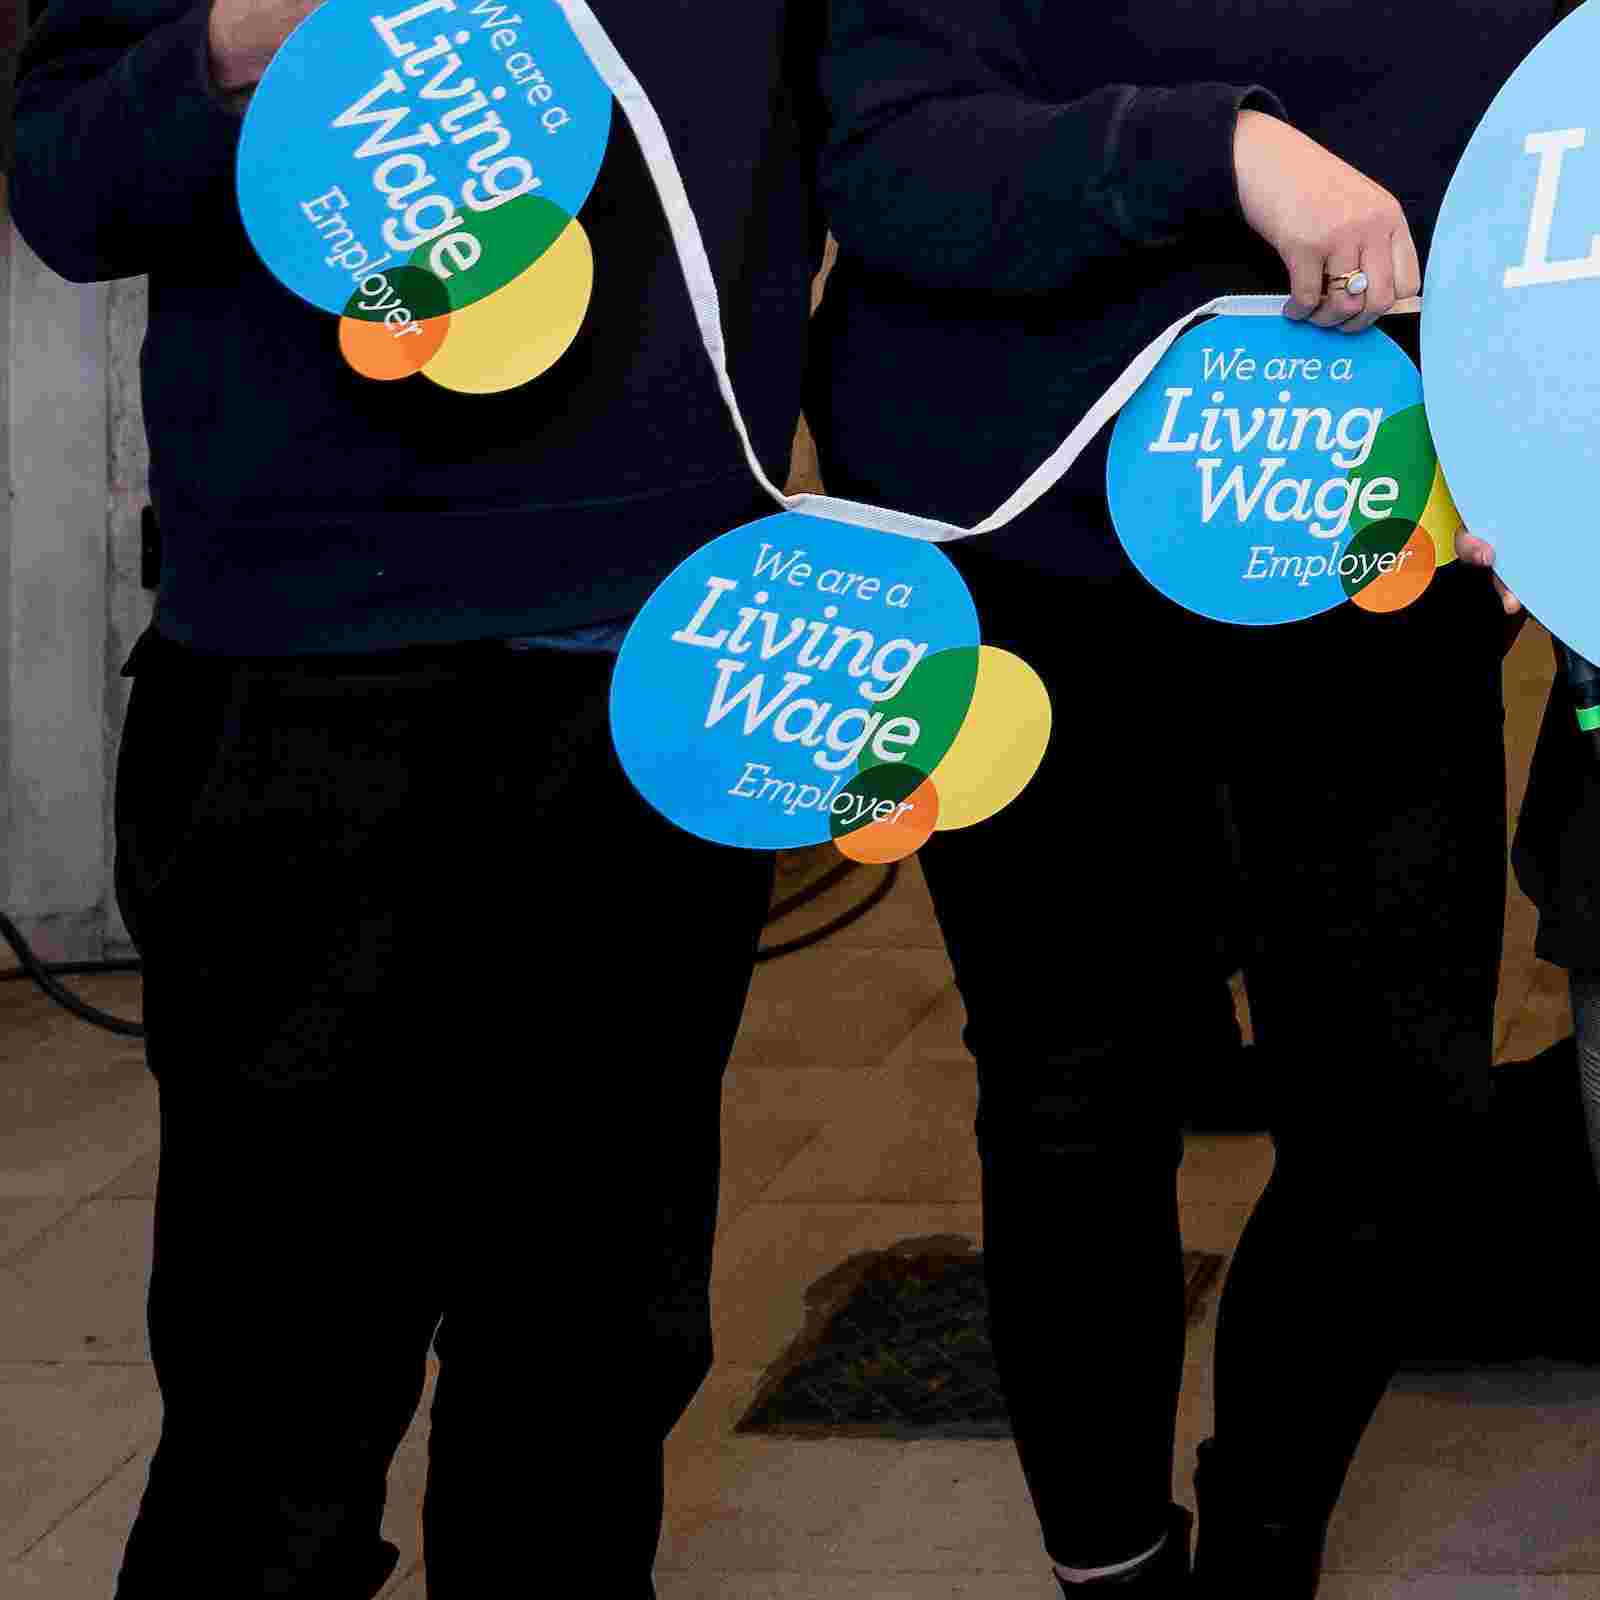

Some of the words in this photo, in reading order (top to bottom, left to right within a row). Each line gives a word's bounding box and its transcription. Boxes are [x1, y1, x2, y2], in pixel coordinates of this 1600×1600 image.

[506, 47, 552, 104] are
[542, 105, 570, 134] a
[331, 69, 481, 279] Wage
[301, 184, 423, 339] Employer
[1201, 348, 1256, 382] We
[1264, 357, 1322, 381] are
[1329, 358, 1353, 381] a
[1148, 387, 1383, 469] Living
[1196, 458, 1399, 538] Wage
[752, 543, 811, 587] We
[816, 566, 881, 600] are
[885, 582, 912, 609] a
[1242, 542, 1412, 586] Employer
[672, 576, 928, 701] Living
[704, 659, 921, 772] Wage
[728, 762, 914, 825] Employer
